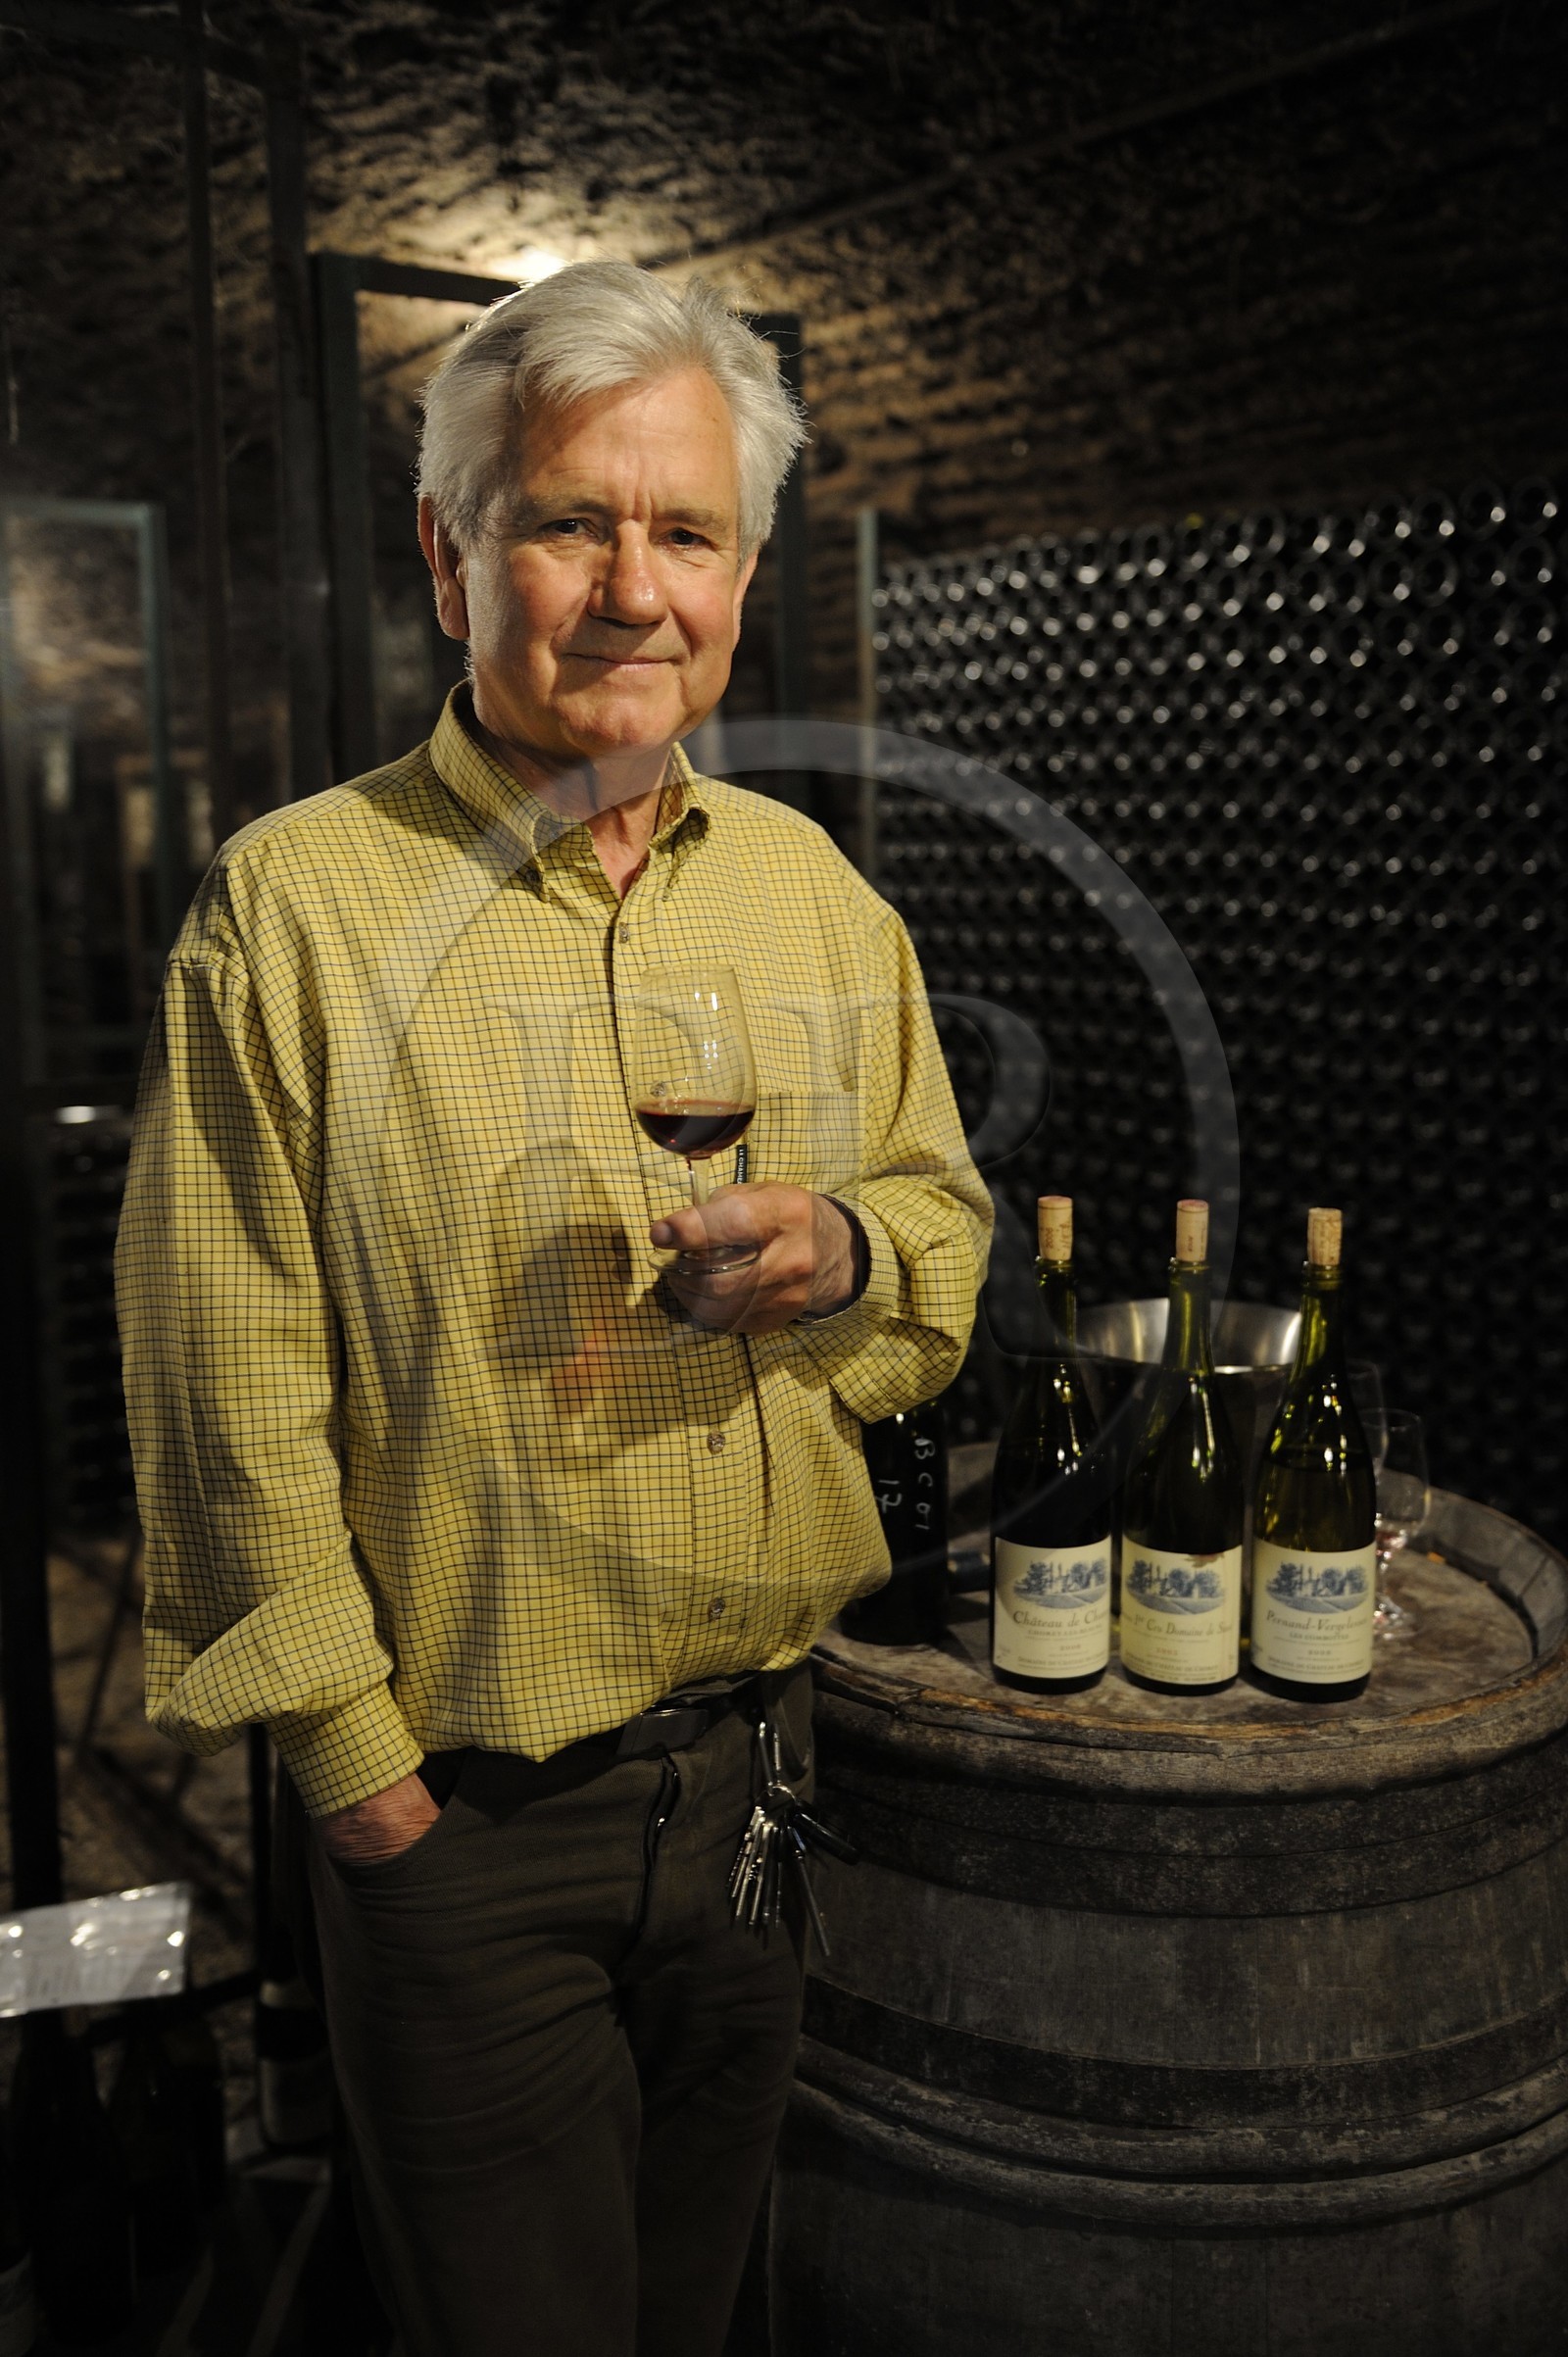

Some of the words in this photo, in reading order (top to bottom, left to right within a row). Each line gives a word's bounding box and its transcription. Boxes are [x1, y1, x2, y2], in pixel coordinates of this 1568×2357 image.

[1012, 1610, 1062, 1628] Château
[1068, 1612, 1080, 1627] de
[1147, 1618, 1162, 1632] Cru
[1166, 1622, 1202, 1636] Domaine
